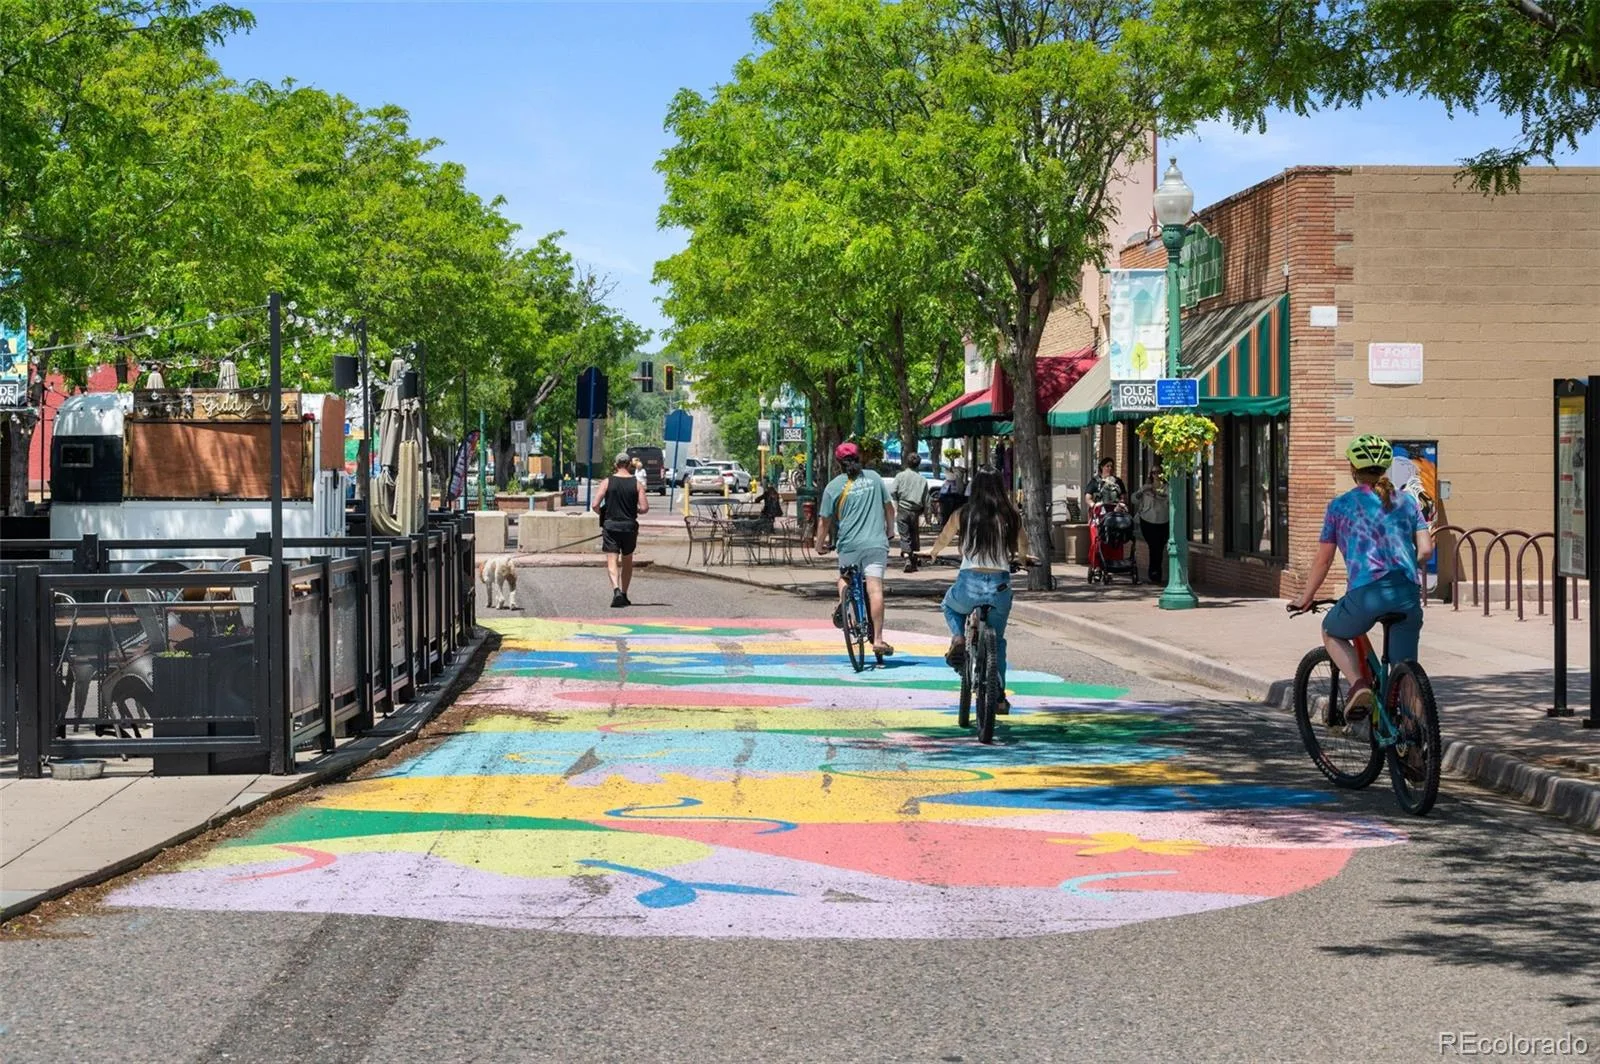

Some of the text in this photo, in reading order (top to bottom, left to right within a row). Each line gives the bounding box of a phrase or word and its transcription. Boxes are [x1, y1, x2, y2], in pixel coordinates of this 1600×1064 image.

[1384, 347, 1409, 358] FOR
[1373, 358, 1420, 369] LEASE
[1123, 386, 1153, 396] OLDE
[202, 393, 250, 417] Giddy
[1122, 395, 1155, 405] TOWN
